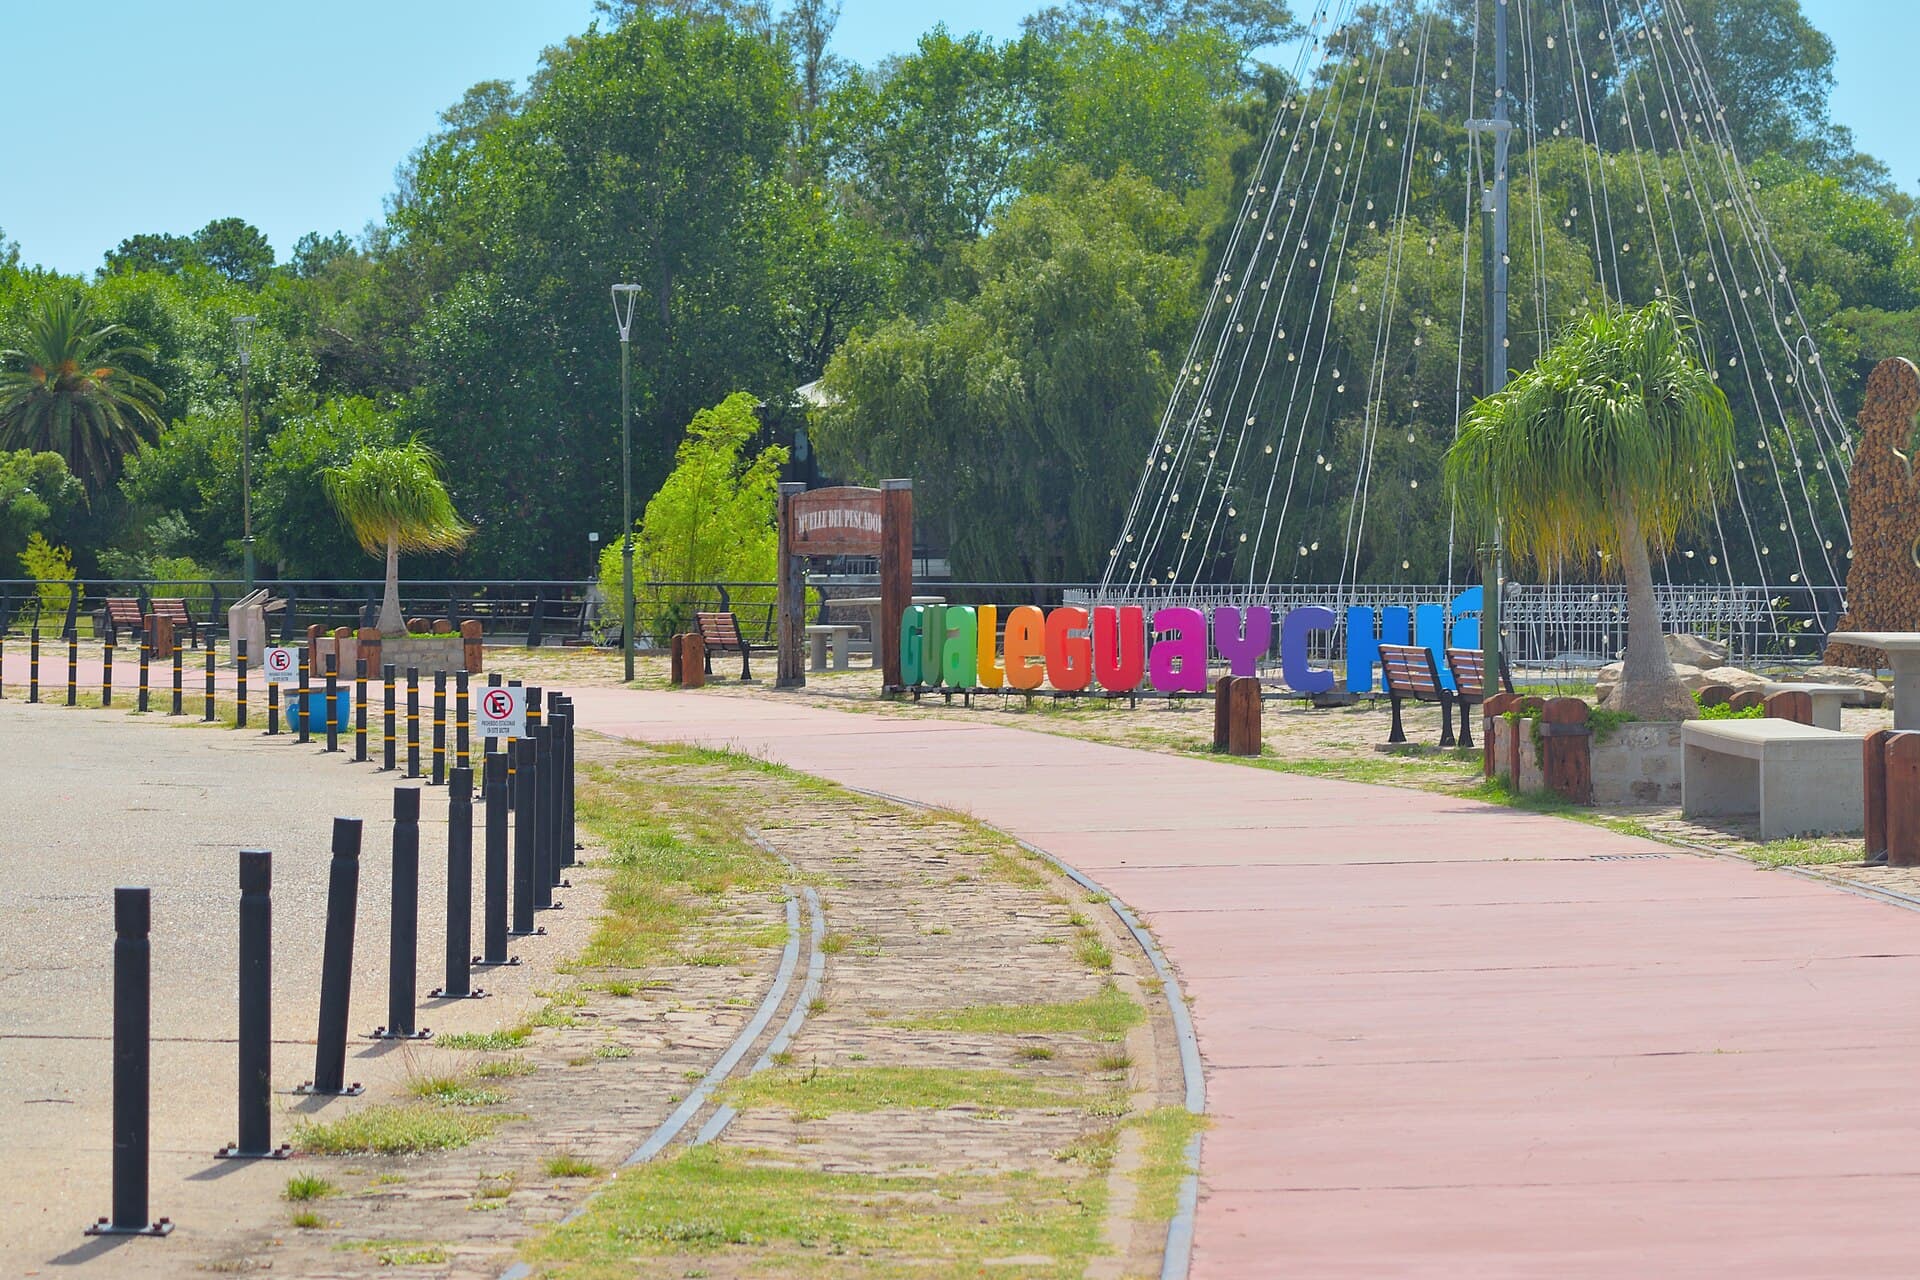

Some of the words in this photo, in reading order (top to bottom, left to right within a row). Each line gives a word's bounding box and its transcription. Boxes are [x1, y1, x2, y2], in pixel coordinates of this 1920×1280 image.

[828, 509, 843, 528] DEL
[276, 655, 285, 666] E
[492, 696, 505, 713] E
